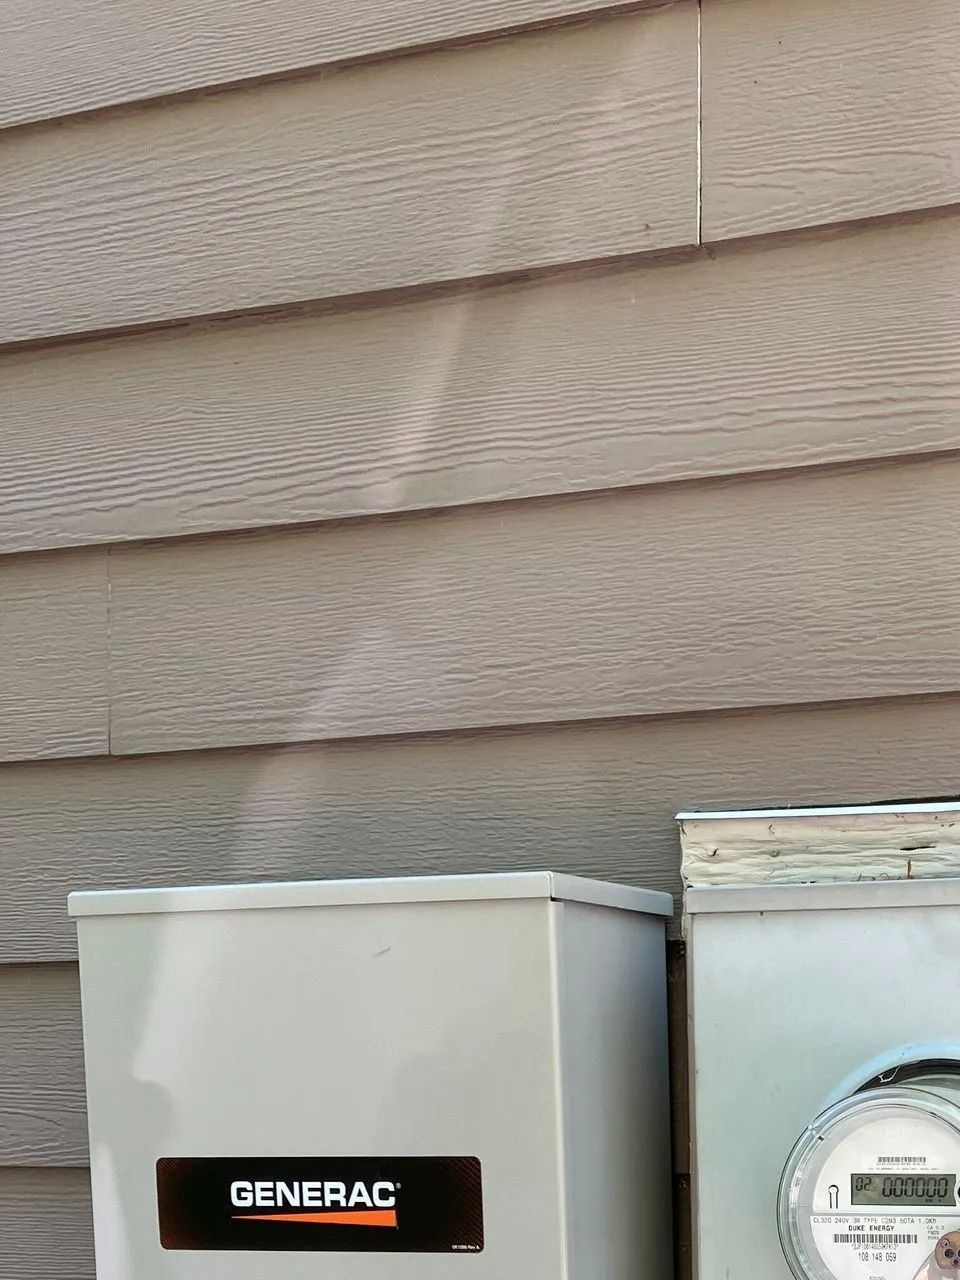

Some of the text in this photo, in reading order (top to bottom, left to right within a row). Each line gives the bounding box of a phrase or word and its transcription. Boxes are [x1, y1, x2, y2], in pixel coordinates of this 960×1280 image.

[230, 1181, 396, 1208] GENERAC
[856, 1177, 948, 1198] 02 000000
[858, 1252, 896, 1262] 108 148 059
